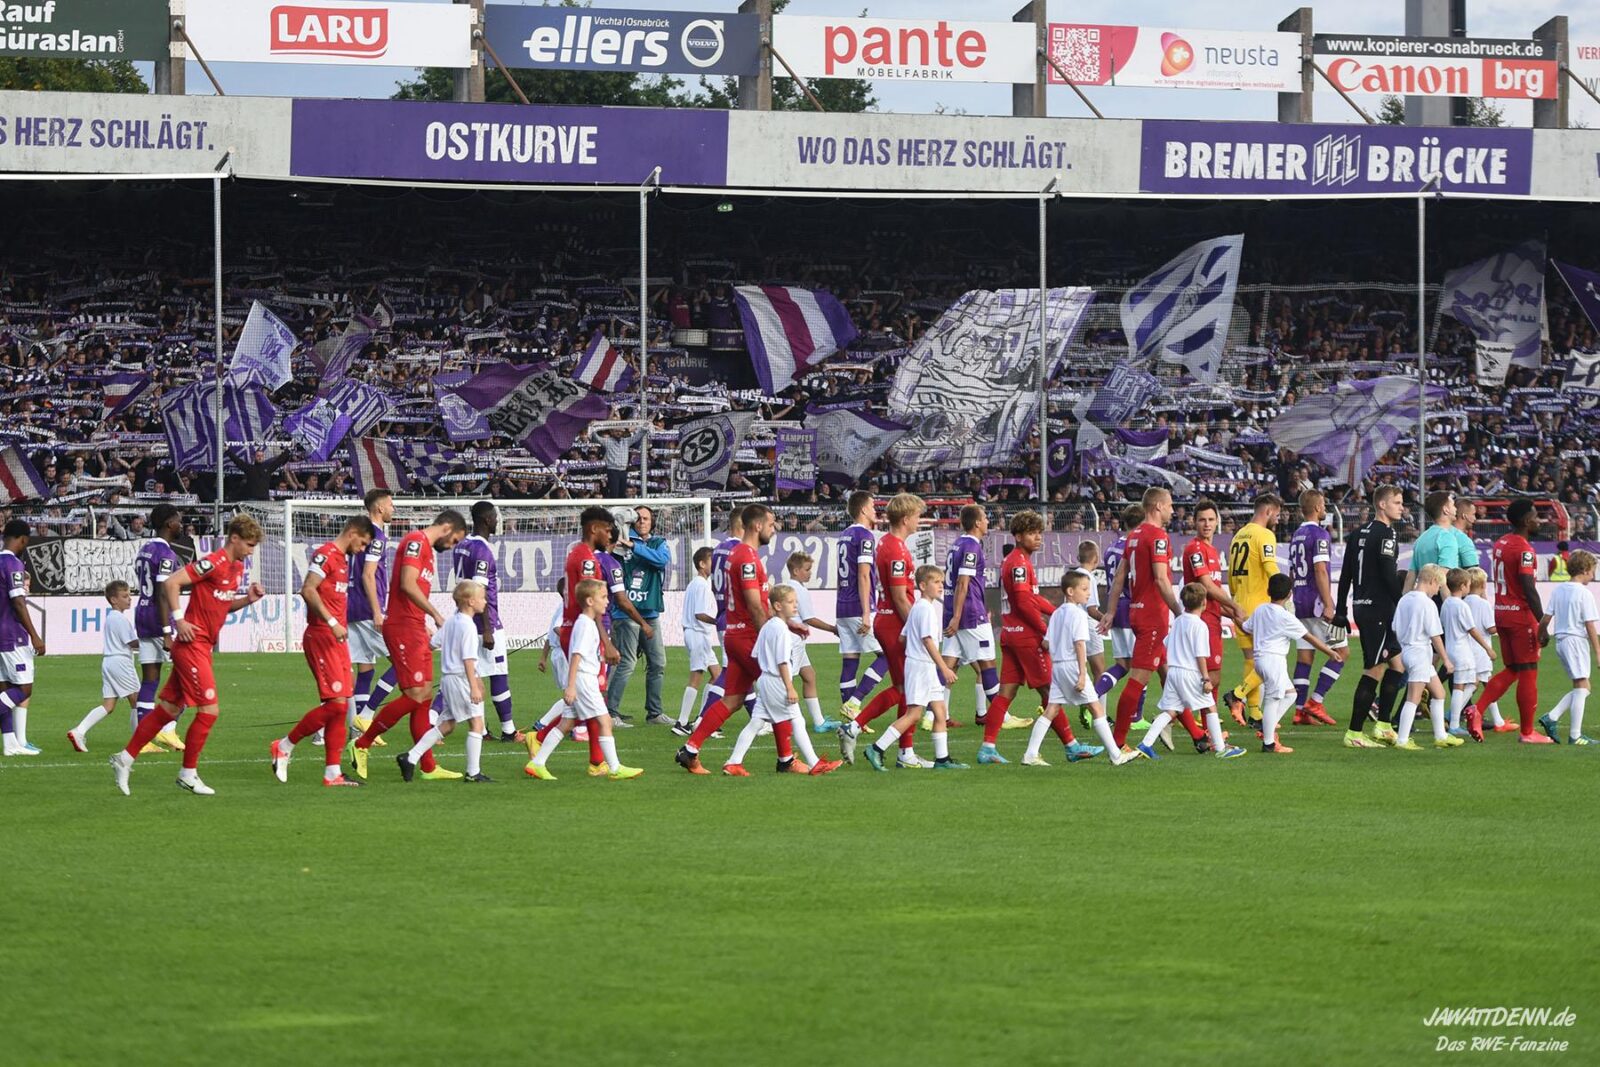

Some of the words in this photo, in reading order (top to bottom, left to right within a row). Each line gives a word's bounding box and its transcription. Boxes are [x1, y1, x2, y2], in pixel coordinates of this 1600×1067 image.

[278, 14, 381, 45] LARU
[523, 15, 669, 66] ellers
[687, 40, 718, 48] VOLVO
[825, 21, 987, 75] pante
[1205, 44, 1279, 66] neusta
[1327, 39, 1543, 57] www.kopierer-osnabrueck.de
[857, 67, 953, 79] MÖBELFABRIK
[1329, 58, 1469, 94] Canon
[1495, 62, 1544, 97] brg
[15, 116, 83, 147] HERZ
[90, 114, 214, 150] SCHLÄGT.
[425, 121, 598, 164] OSTKURVE
[798, 136, 836, 164] WO
[843, 138, 891, 165] DAS
[897, 140, 957, 166] HERZ
[962, 135, 1072, 169] SCHLÄGT.
[1165, 142, 1307, 181] BREMER
[1367, 137, 1507, 184] BRÜCKE
[1231, 541, 1249, 576] 22
